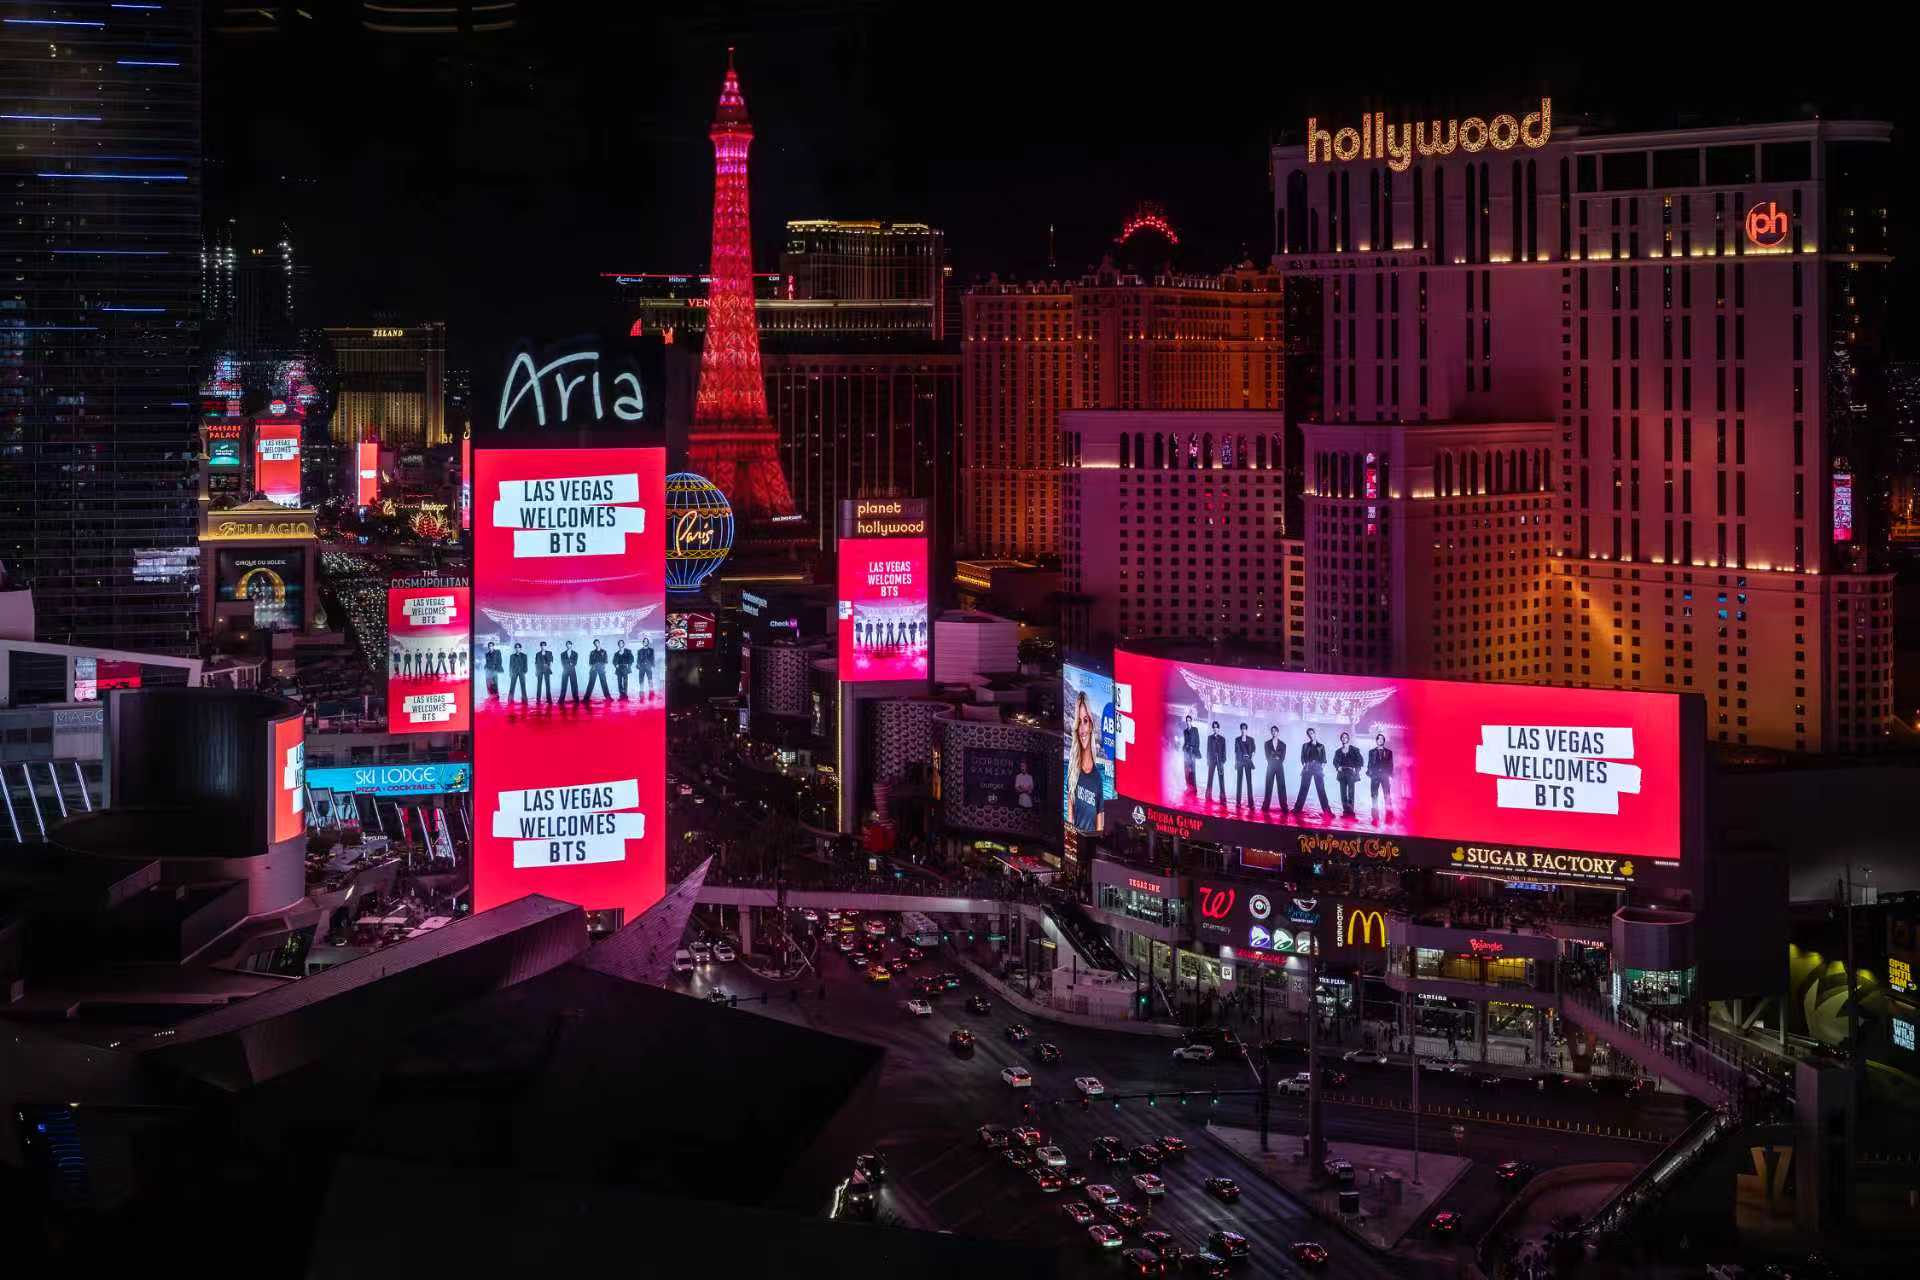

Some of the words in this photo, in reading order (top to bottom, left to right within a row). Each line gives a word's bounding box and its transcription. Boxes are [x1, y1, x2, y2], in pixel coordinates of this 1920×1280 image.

[1308, 97, 1551, 172] hollywood
[1751, 202, 1788, 240] ph
[372, 329, 403, 337] ISLAND
[498, 352, 644, 430] Aria
[264, 446, 291, 454] WELCOMES
[524, 480, 554, 502] LAS
[561, 479, 613, 501] VEGAS
[520, 506, 616, 529] WELCOMES
[857, 501, 902, 518] planet
[216, 521, 309, 537] BELLAGIO
[676, 510, 714, 556] Paris
[857, 520, 924, 536] hollywood
[550, 532, 586, 553] BTS
[868, 561, 884, 573] LAS
[885, 561, 911, 572] VEGAS
[391, 577, 469, 589] COSMOPOLITAN
[867, 573, 912, 585] WELCOMES
[880, 586, 899, 597] BTS
[413, 599, 424, 607] LAS
[425, 597, 446, 606] VEGAS
[411, 606, 446, 616] WELCOMES
[422, 616, 436, 624] BTS
[413, 695, 424, 704] LAS
[425, 695, 446, 703] VEGAS
[411, 703, 447, 713] WELCOMES
[422, 713, 436, 721] BTS
[1508, 726, 1540, 750] LAS
[1545, 728, 1605, 755] VEGAS
[355, 770, 376, 785] SKI
[381, 767, 435, 784] LODGE
[1503, 754, 1608, 784] WELCOMES
[386, 784, 436, 792] COCKTAILS
[1535, 784, 1575, 808] BTS
[523, 790, 554, 812] LAS
[559, 787, 613, 810] VEGAS
[520, 813, 616, 838] WELCOMES
[550, 840, 586, 863] BTS
[1298, 834, 1361, 859] Rainforest
[1467, 847, 1528, 867] SUGAR
[1531, 853, 1616, 875] FACTORY
[1470, 938, 1504, 953] Bojangles
[1888, 958, 1909, 972] OPEN
[1888, 967, 1911, 981] UNTIL
[1894, 1025, 1914, 1041] WILD
